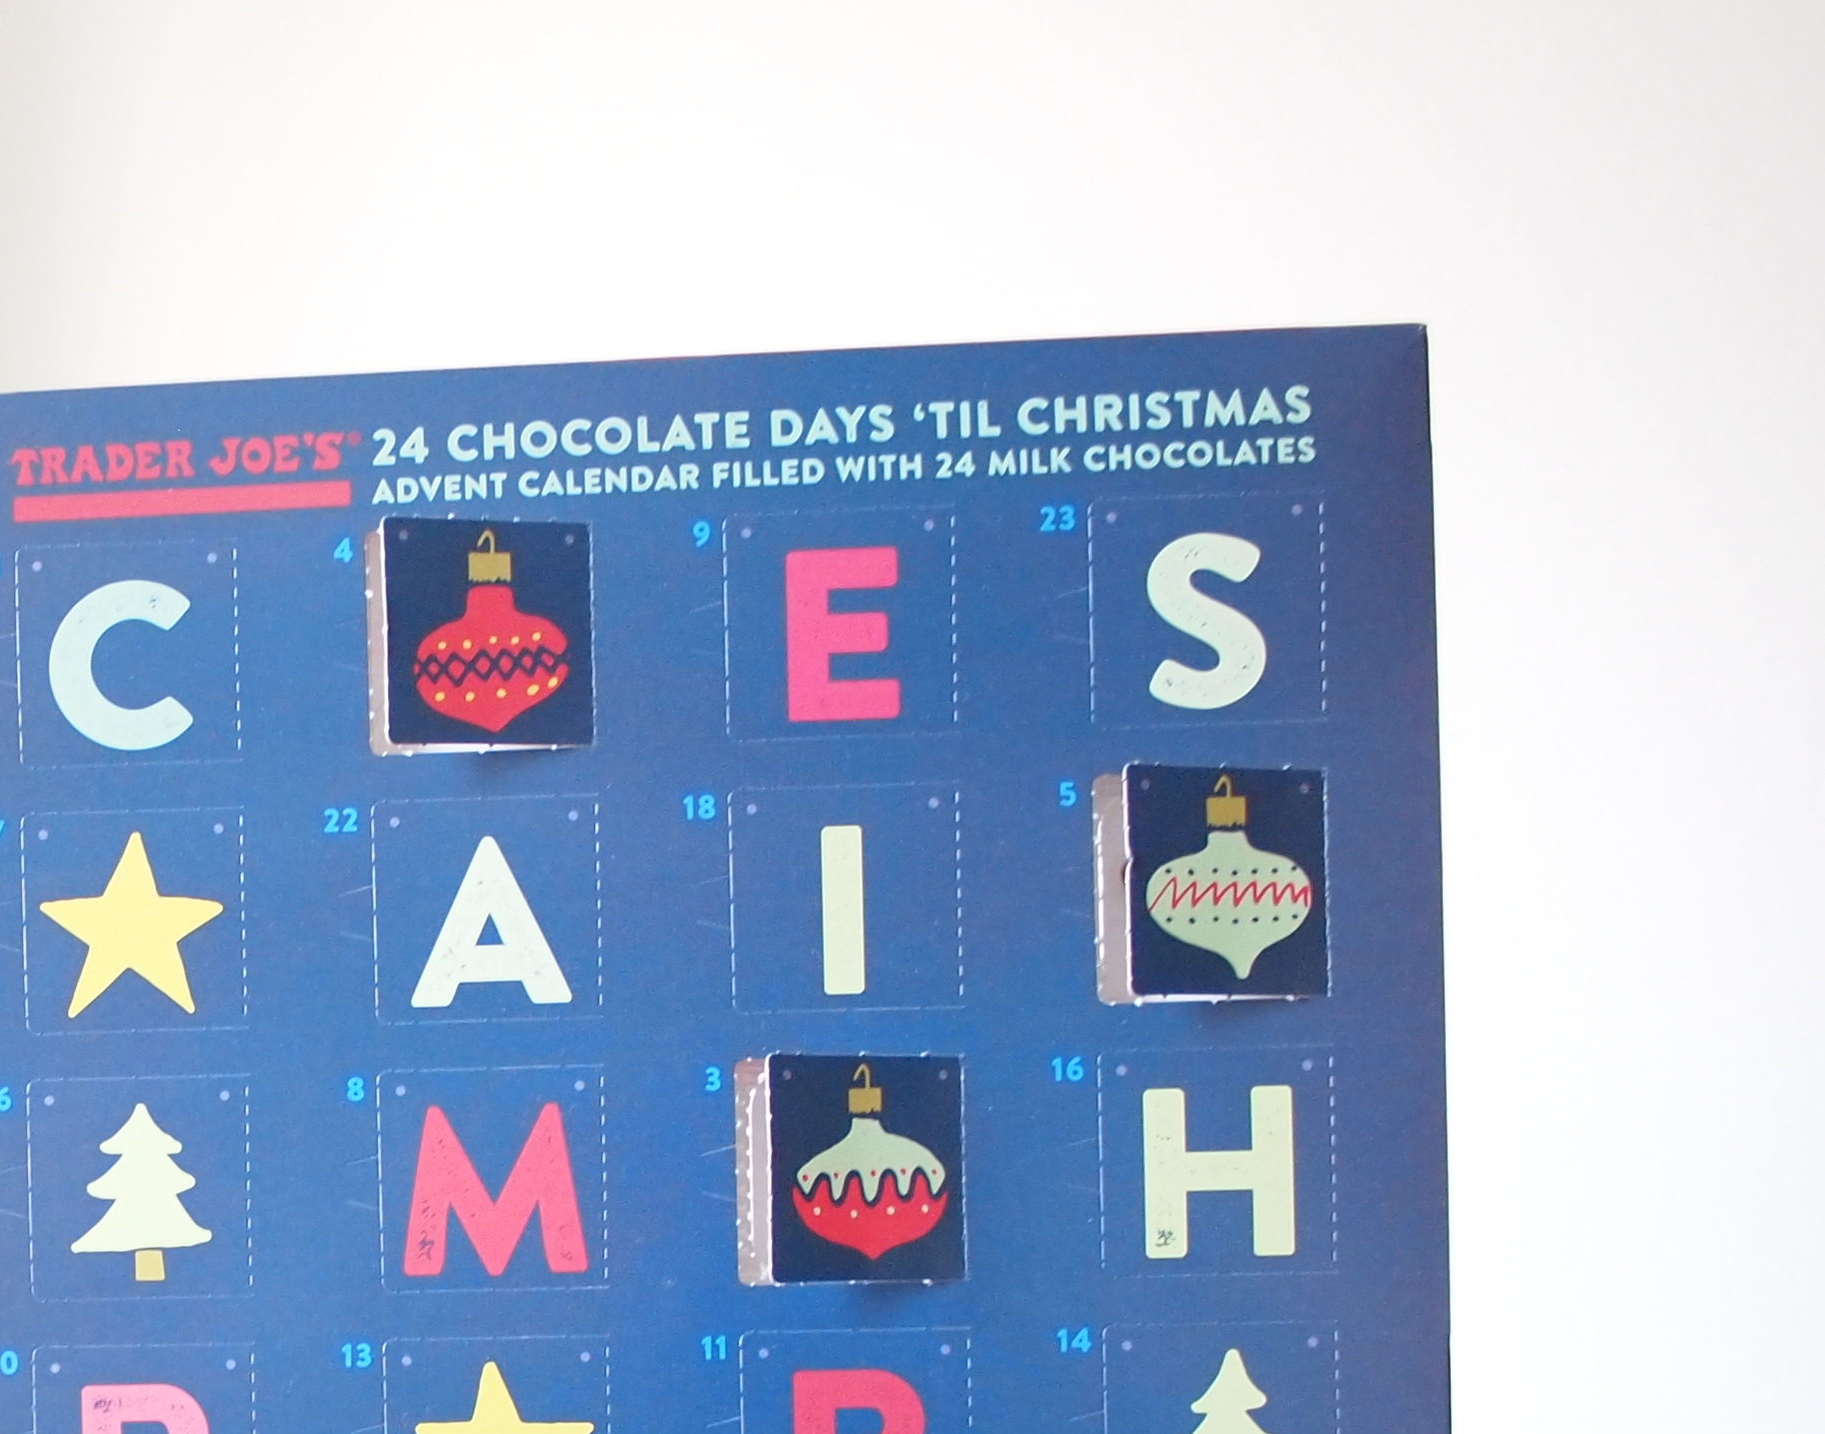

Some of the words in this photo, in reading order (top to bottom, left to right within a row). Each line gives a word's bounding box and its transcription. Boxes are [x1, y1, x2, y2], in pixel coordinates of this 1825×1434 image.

[372, 425, 430, 467] 24
[446, 410, 751, 464] CHOCOLATE
[770, 405, 895, 449] DAYS
[1016, 384, 1312, 438] CHRISTMAS
[10, 439, 196, 487] TRADER
[371, 470, 508, 506] ADVENT
[517, 461, 701, 498] CALENDAR
[712, 454, 826, 489] FILLED
[835, 453, 924, 484] WITH
[934, 449, 977, 480] 24
[987, 446, 1073, 478] MILK
[1082, 435, 1317, 474] CHOCOLATES
[1039, 504, 1076, 533] 23
[691, 520, 712, 548] 9
[332, 536, 355, 564] 4
[784, 545, 902, 723] E
[1146, 531, 1268, 710] S
[47, 578, 195, 751] C
[682, 793, 717, 821] 18
[1058, 780, 1078, 808] 5
[322, 806, 359, 834] 22
[409, 834, 574, 1009] A
[819, 823, 867, 996] I
[704, 1065, 722, 1093] 3
[1050, 1055, 1085, 1083] 16
[345, 1075, 366, 1103] 8
[1141, 1084, 1297, 1260] H
[402, 1101, 590, 1278] M
[700, 1334, 727, 1362] 11
[1055, 1326, 1093, 1354] 14
[340, 1341, 373, 1369] 13
